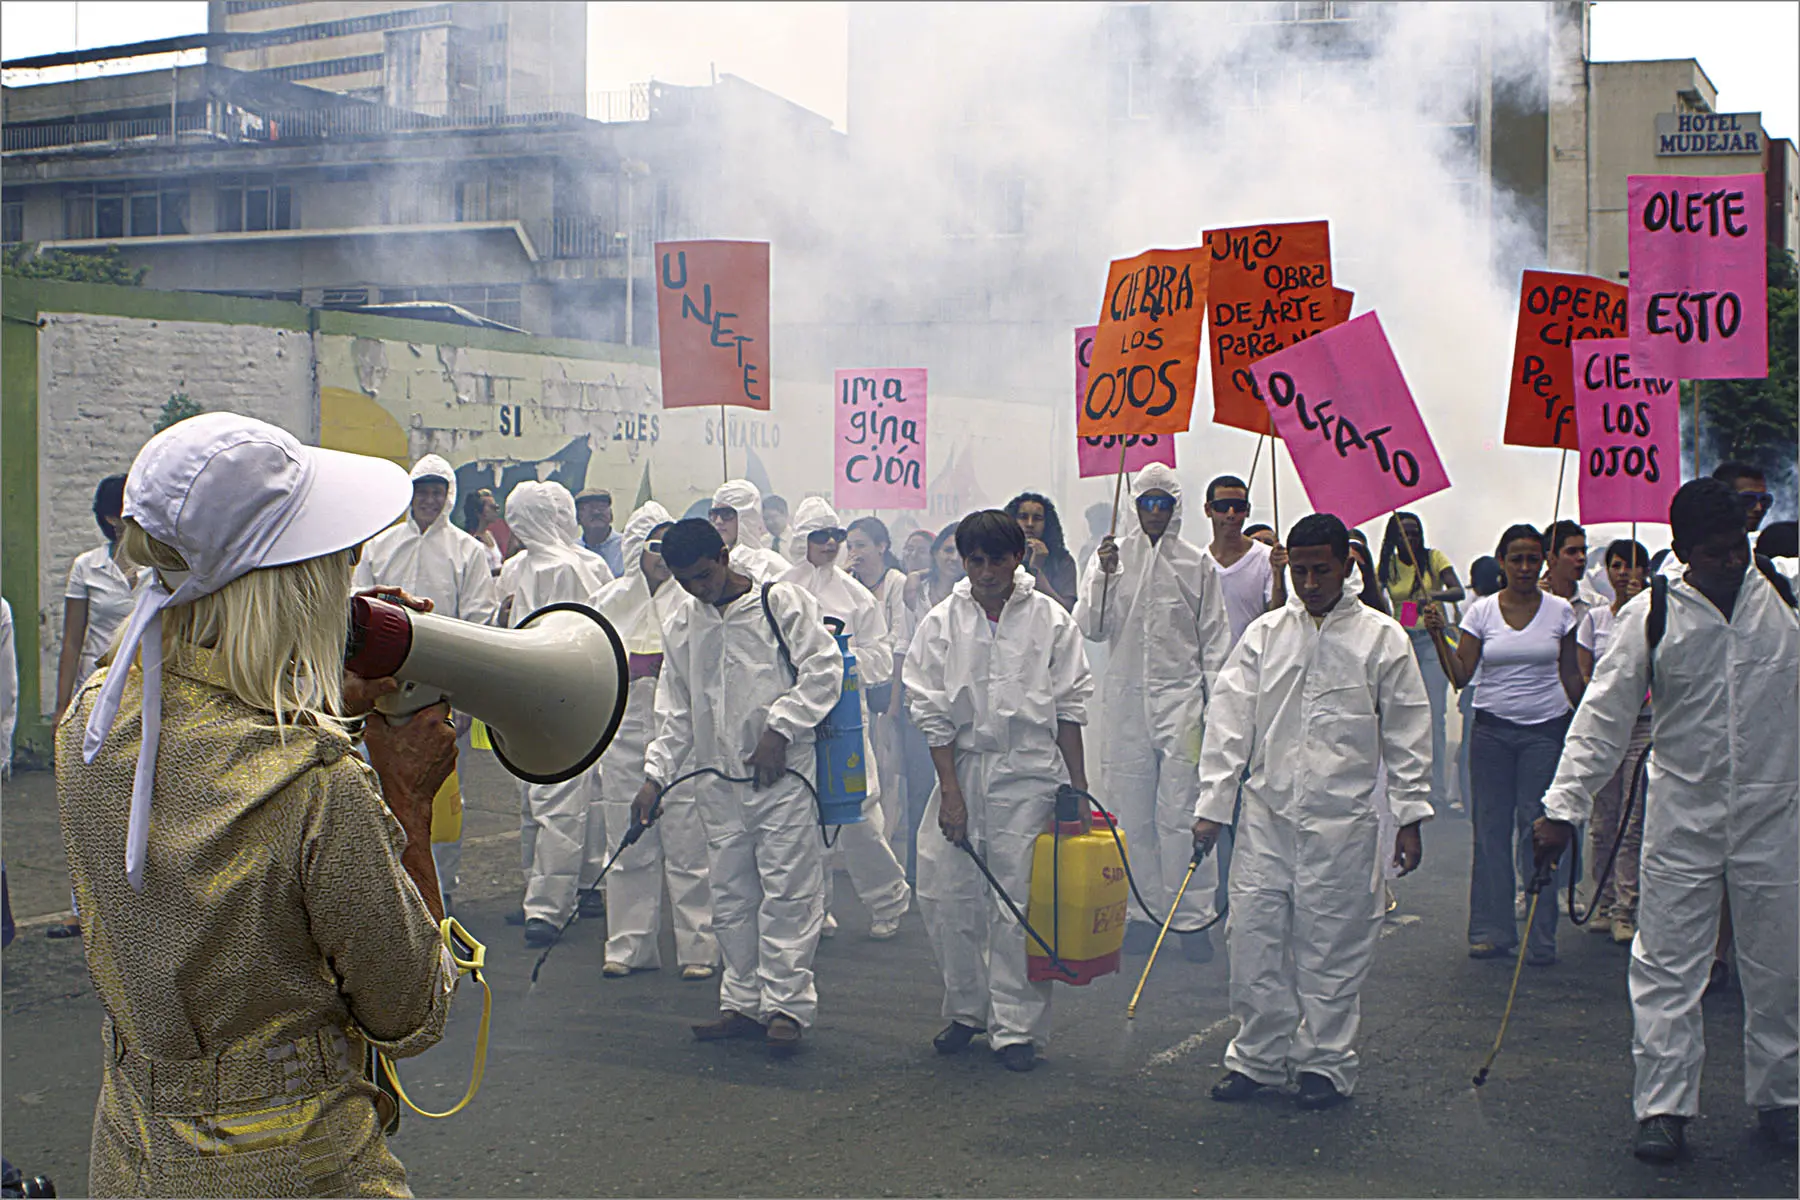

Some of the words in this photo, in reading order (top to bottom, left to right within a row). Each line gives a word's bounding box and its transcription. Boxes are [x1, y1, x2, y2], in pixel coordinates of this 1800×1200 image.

[1660, 133, 1760, 152] MUDEJAR
[1678, 113, 1742, 133] HOTEL
[1643, 189, 1748, 237] OLETE
[1110, 264, 1194, 322] CIERRA
[1214, 302, 1252, 327] DE
[1253, 295, 1326, 331] ARTE
[1527, 285, 1627, 332] OPERA
[663, 251, 761, 400] UNETE
[1647, 291, 1742, 344] ESTO
[1121, 328, 1164, 354] LOS
[1085, 359, 1181, 420] OJOS
[500, 405, 522, 437] SI
[845, 401, 920, 445] gina
[1268, 371, 1420, 488] OLFATO
[1604, 402, 1651, 437] LOS
[1590, 445, 1661, 483] OJOS
